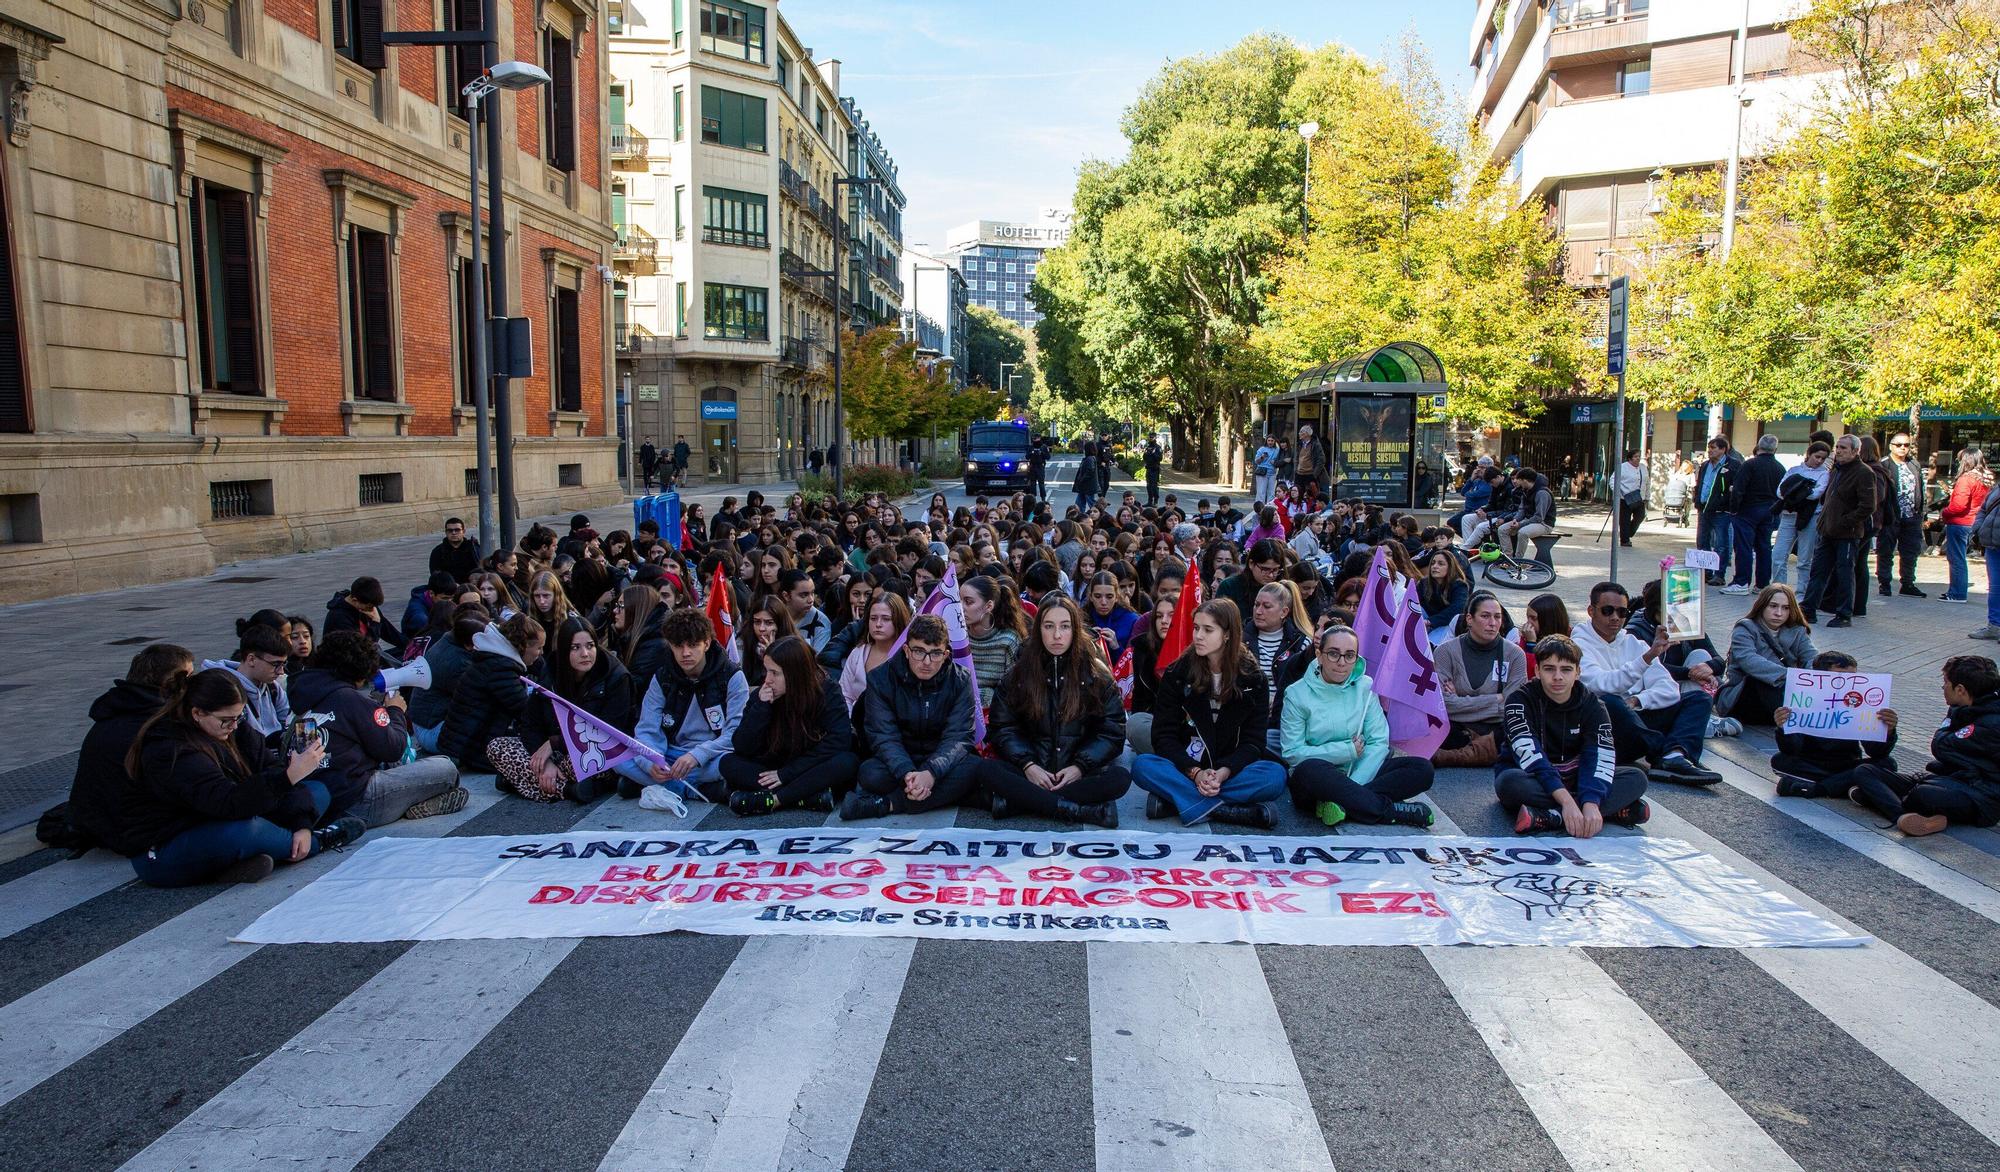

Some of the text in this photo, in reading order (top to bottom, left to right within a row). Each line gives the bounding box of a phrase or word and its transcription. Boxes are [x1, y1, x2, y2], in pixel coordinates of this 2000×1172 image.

[994, 225, 1039, 238] HOTEL
[1352, 442, 1372, 452] SUSTO
[1347, 452, 1371, 463] BESTIAL
[1376, 452, 1400, 463] SUSTOA
[1795, 672, 1870, 690] STOP
[498, 837, 760, 859] SANDRA
[777, 836, 860, 855] EZ
[871, 837, 1172, 860] ZAITUGU
[599, 857, 1342, 888] BULLYING ETA GORROTO
[527, 881, 1450, 917] DISKURTSO GEHIAGORIK EZ!
[753, 904, 1171, 932] Ikasle Sindikatua
